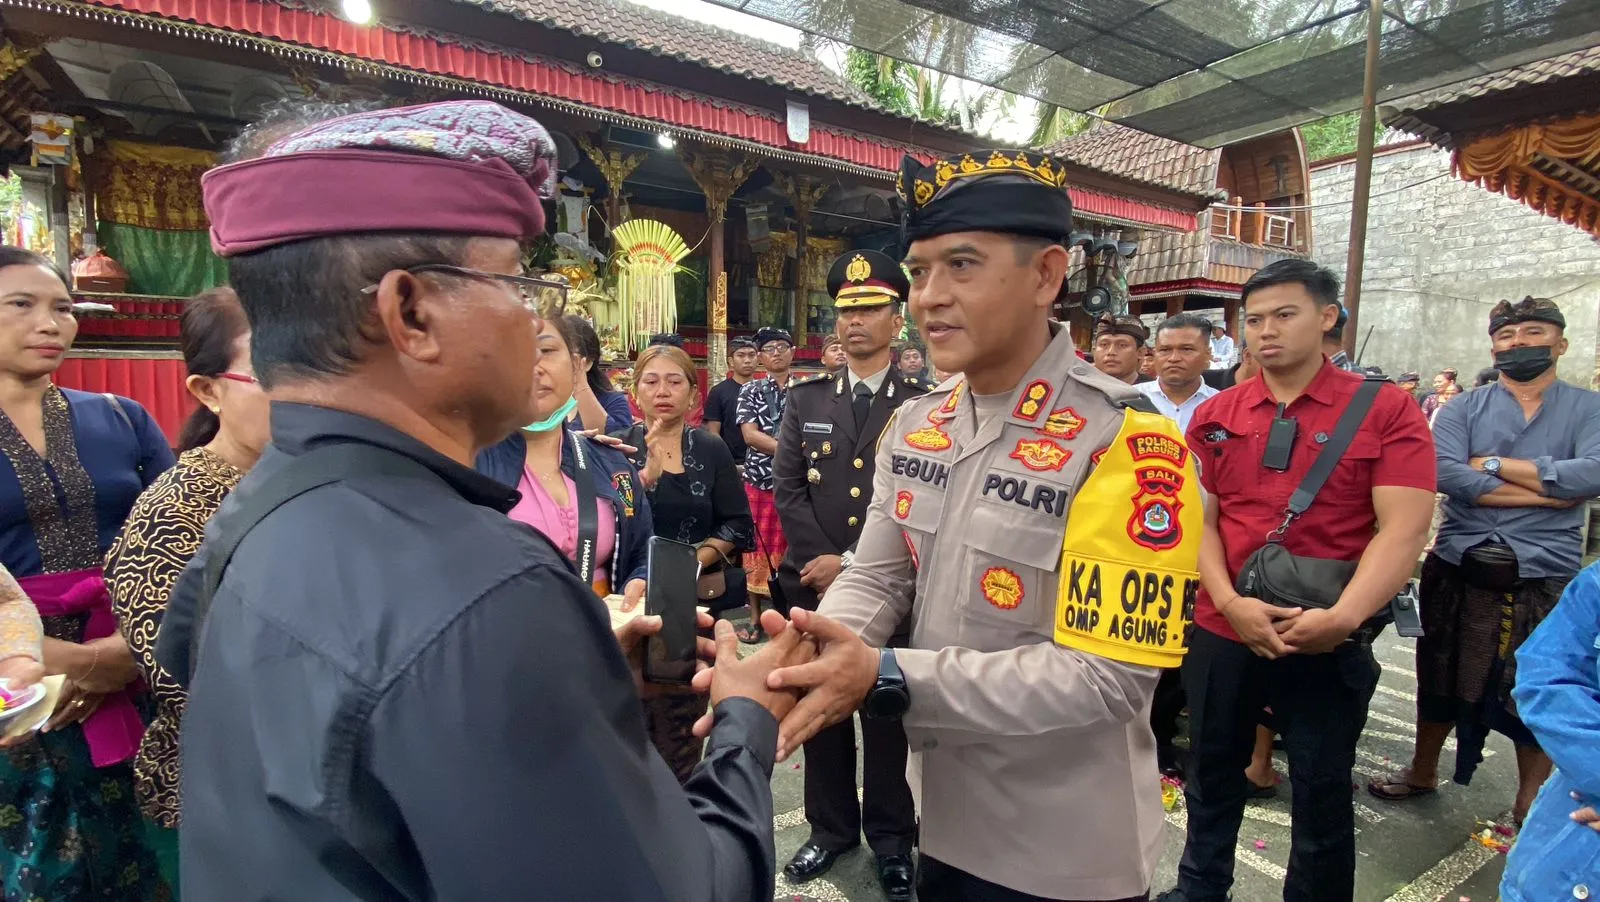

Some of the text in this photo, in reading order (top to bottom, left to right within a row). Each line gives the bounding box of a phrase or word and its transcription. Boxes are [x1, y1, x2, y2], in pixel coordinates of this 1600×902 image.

[1136, 436, 1180, 454] POLRES
[1138, 446, 1180, 460] BADUNG
[891, 454, 950, 489] EGUH
[1146, 470, 1176, 481] BALI
[982, 473, 1068, 518] POLRI
[1068, 559, 1102, 608] KA
[1120, 569, 1174, 620] OPS
[1065, 604, 1100, 633] OMP
[1108, 613, 1168, 646] AGUNG
